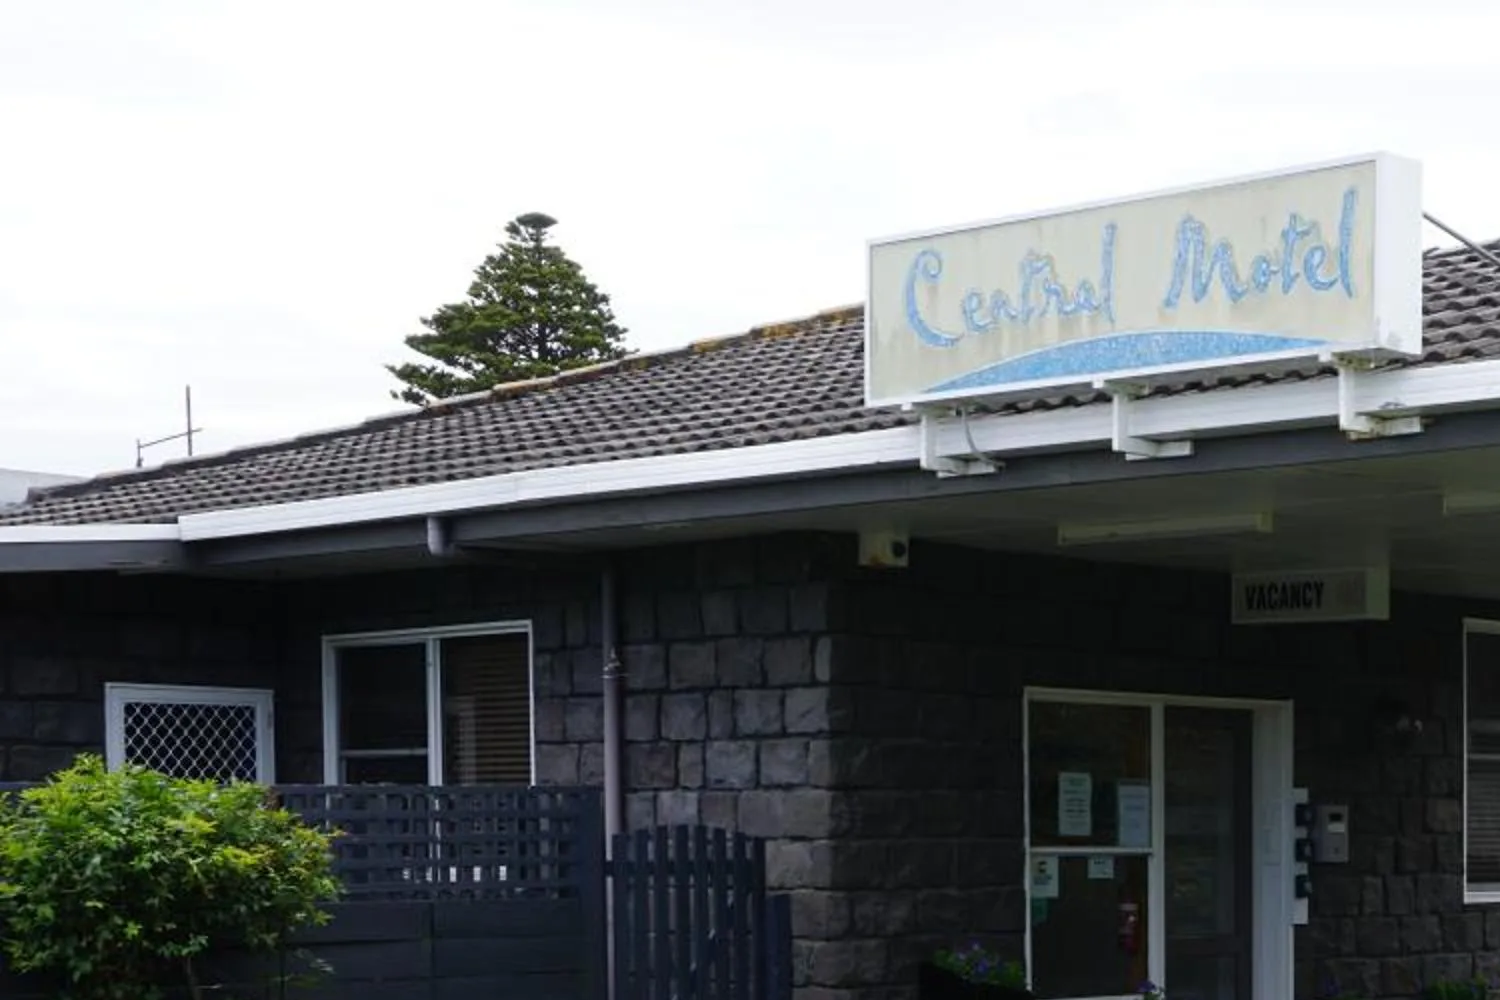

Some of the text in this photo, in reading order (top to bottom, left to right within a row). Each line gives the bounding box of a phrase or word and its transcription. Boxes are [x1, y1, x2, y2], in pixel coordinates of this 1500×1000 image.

[905, 187, 1358, 347] Central Motel
[1245, 581, 1324, 611] VACANCY
